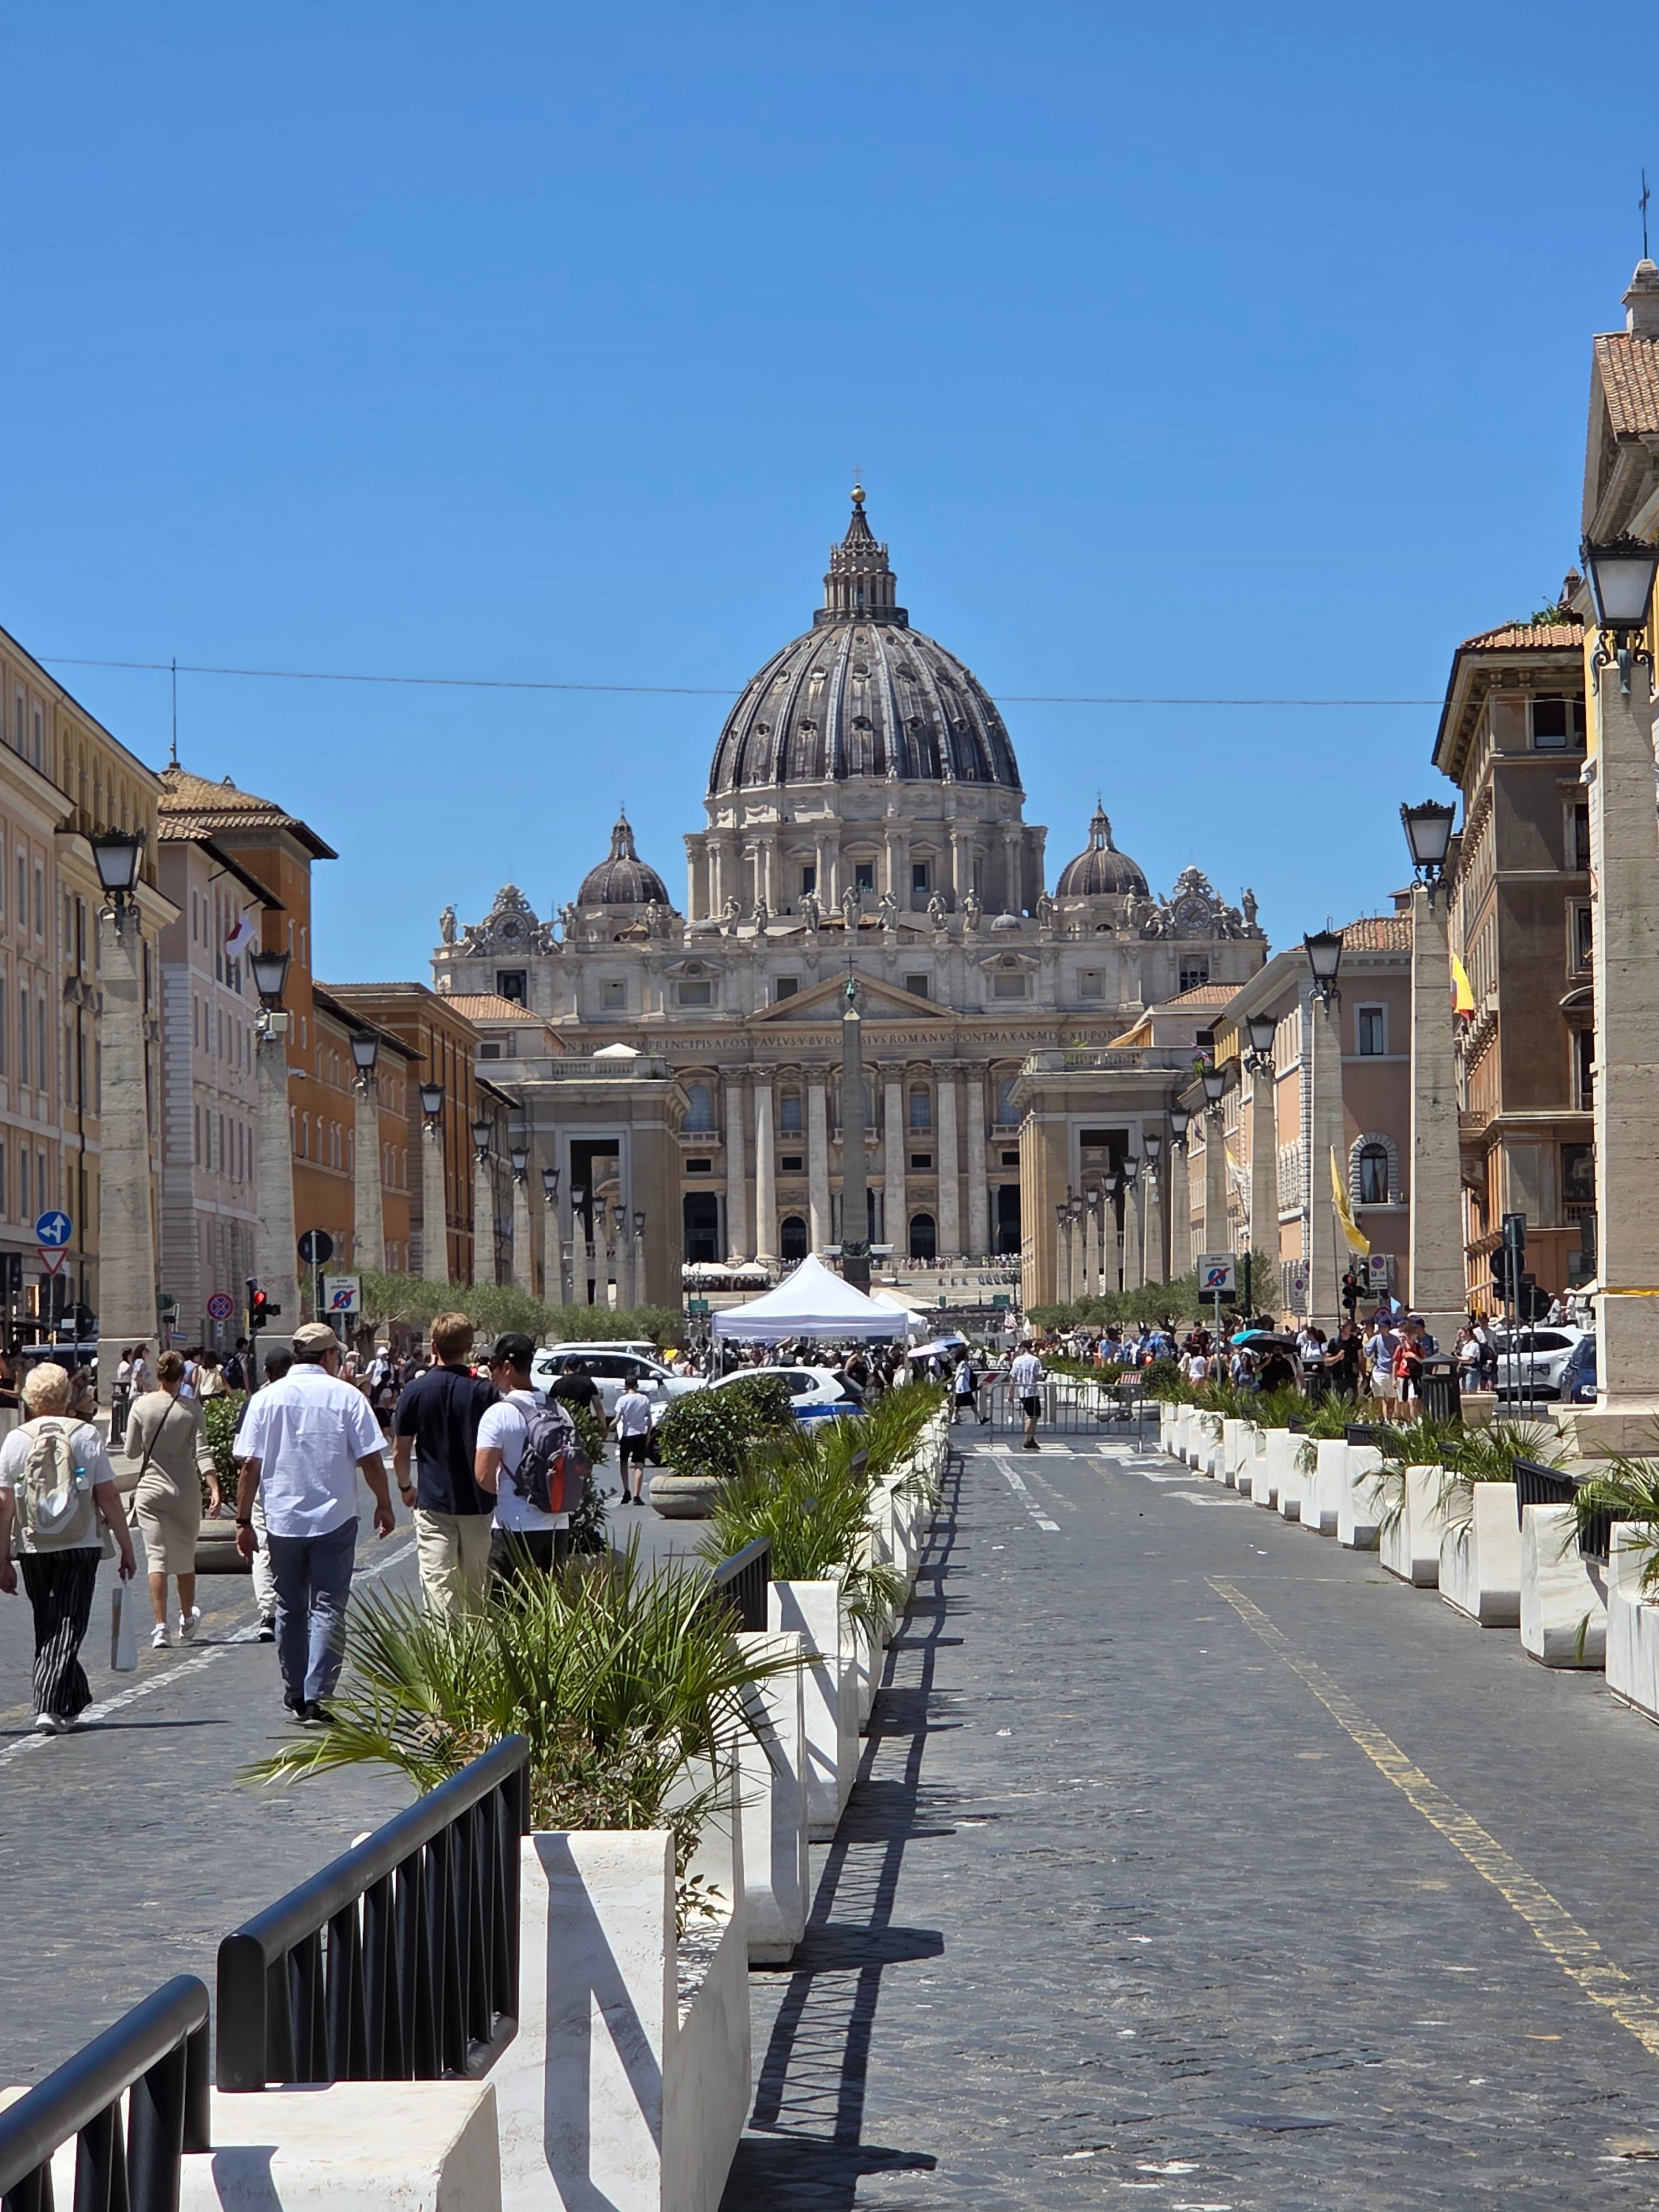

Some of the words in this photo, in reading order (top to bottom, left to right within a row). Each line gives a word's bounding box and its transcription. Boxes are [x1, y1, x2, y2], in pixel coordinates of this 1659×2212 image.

[648, 1040, 712, 1050] PRINCIPIS
[715, 1037, 753, 1048] APOST
[754, 1036, 796, 1047] PAVLVS
[889, 1032, 954, 1044] ROMANVS
